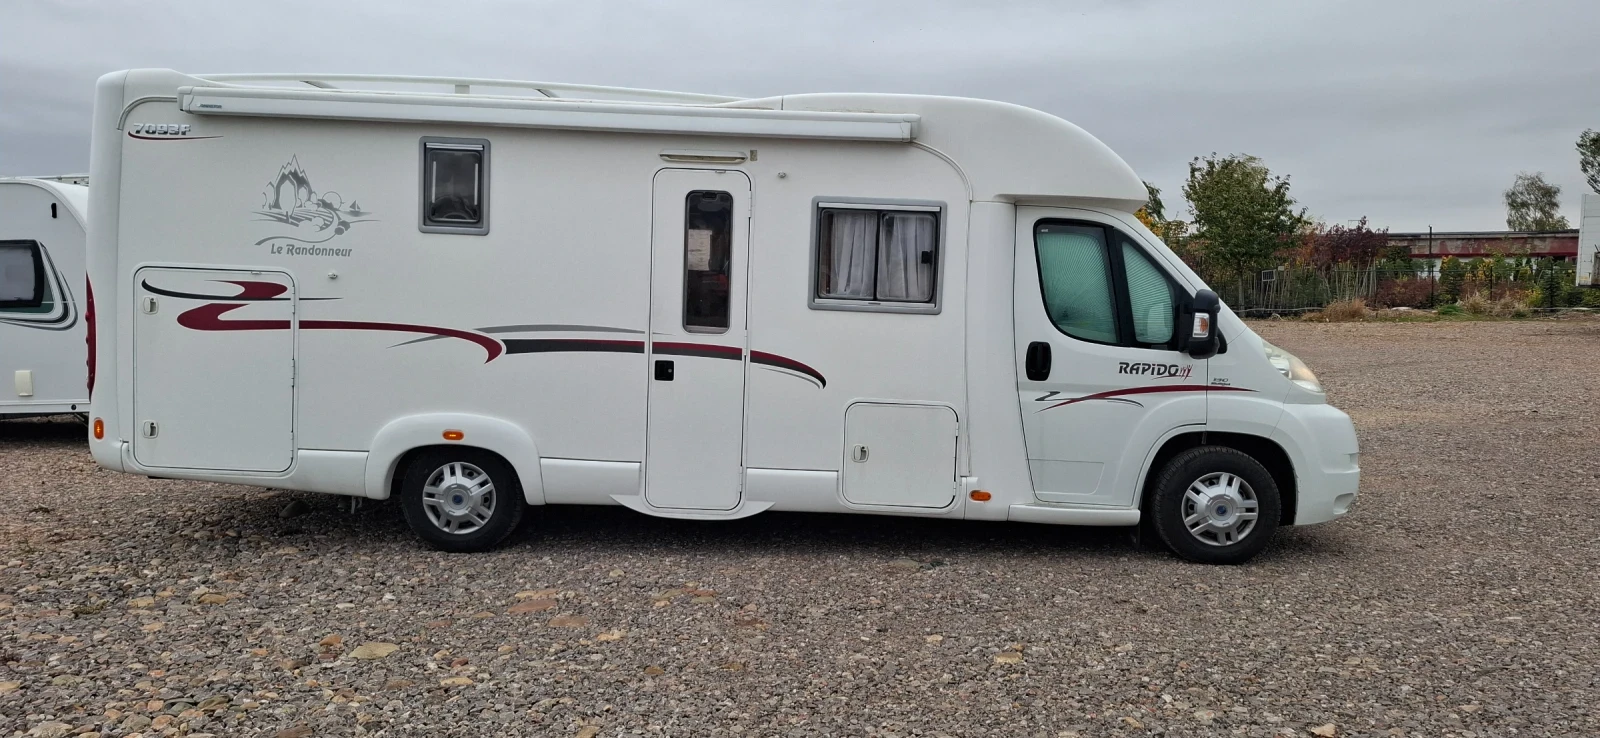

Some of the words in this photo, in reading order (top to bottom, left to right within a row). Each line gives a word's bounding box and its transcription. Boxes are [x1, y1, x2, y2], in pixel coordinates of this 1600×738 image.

[134, 123, 191, 135] 7093F
[270, 243, 283, 254] Le
[286, 244, 352, 257] Randonneur
